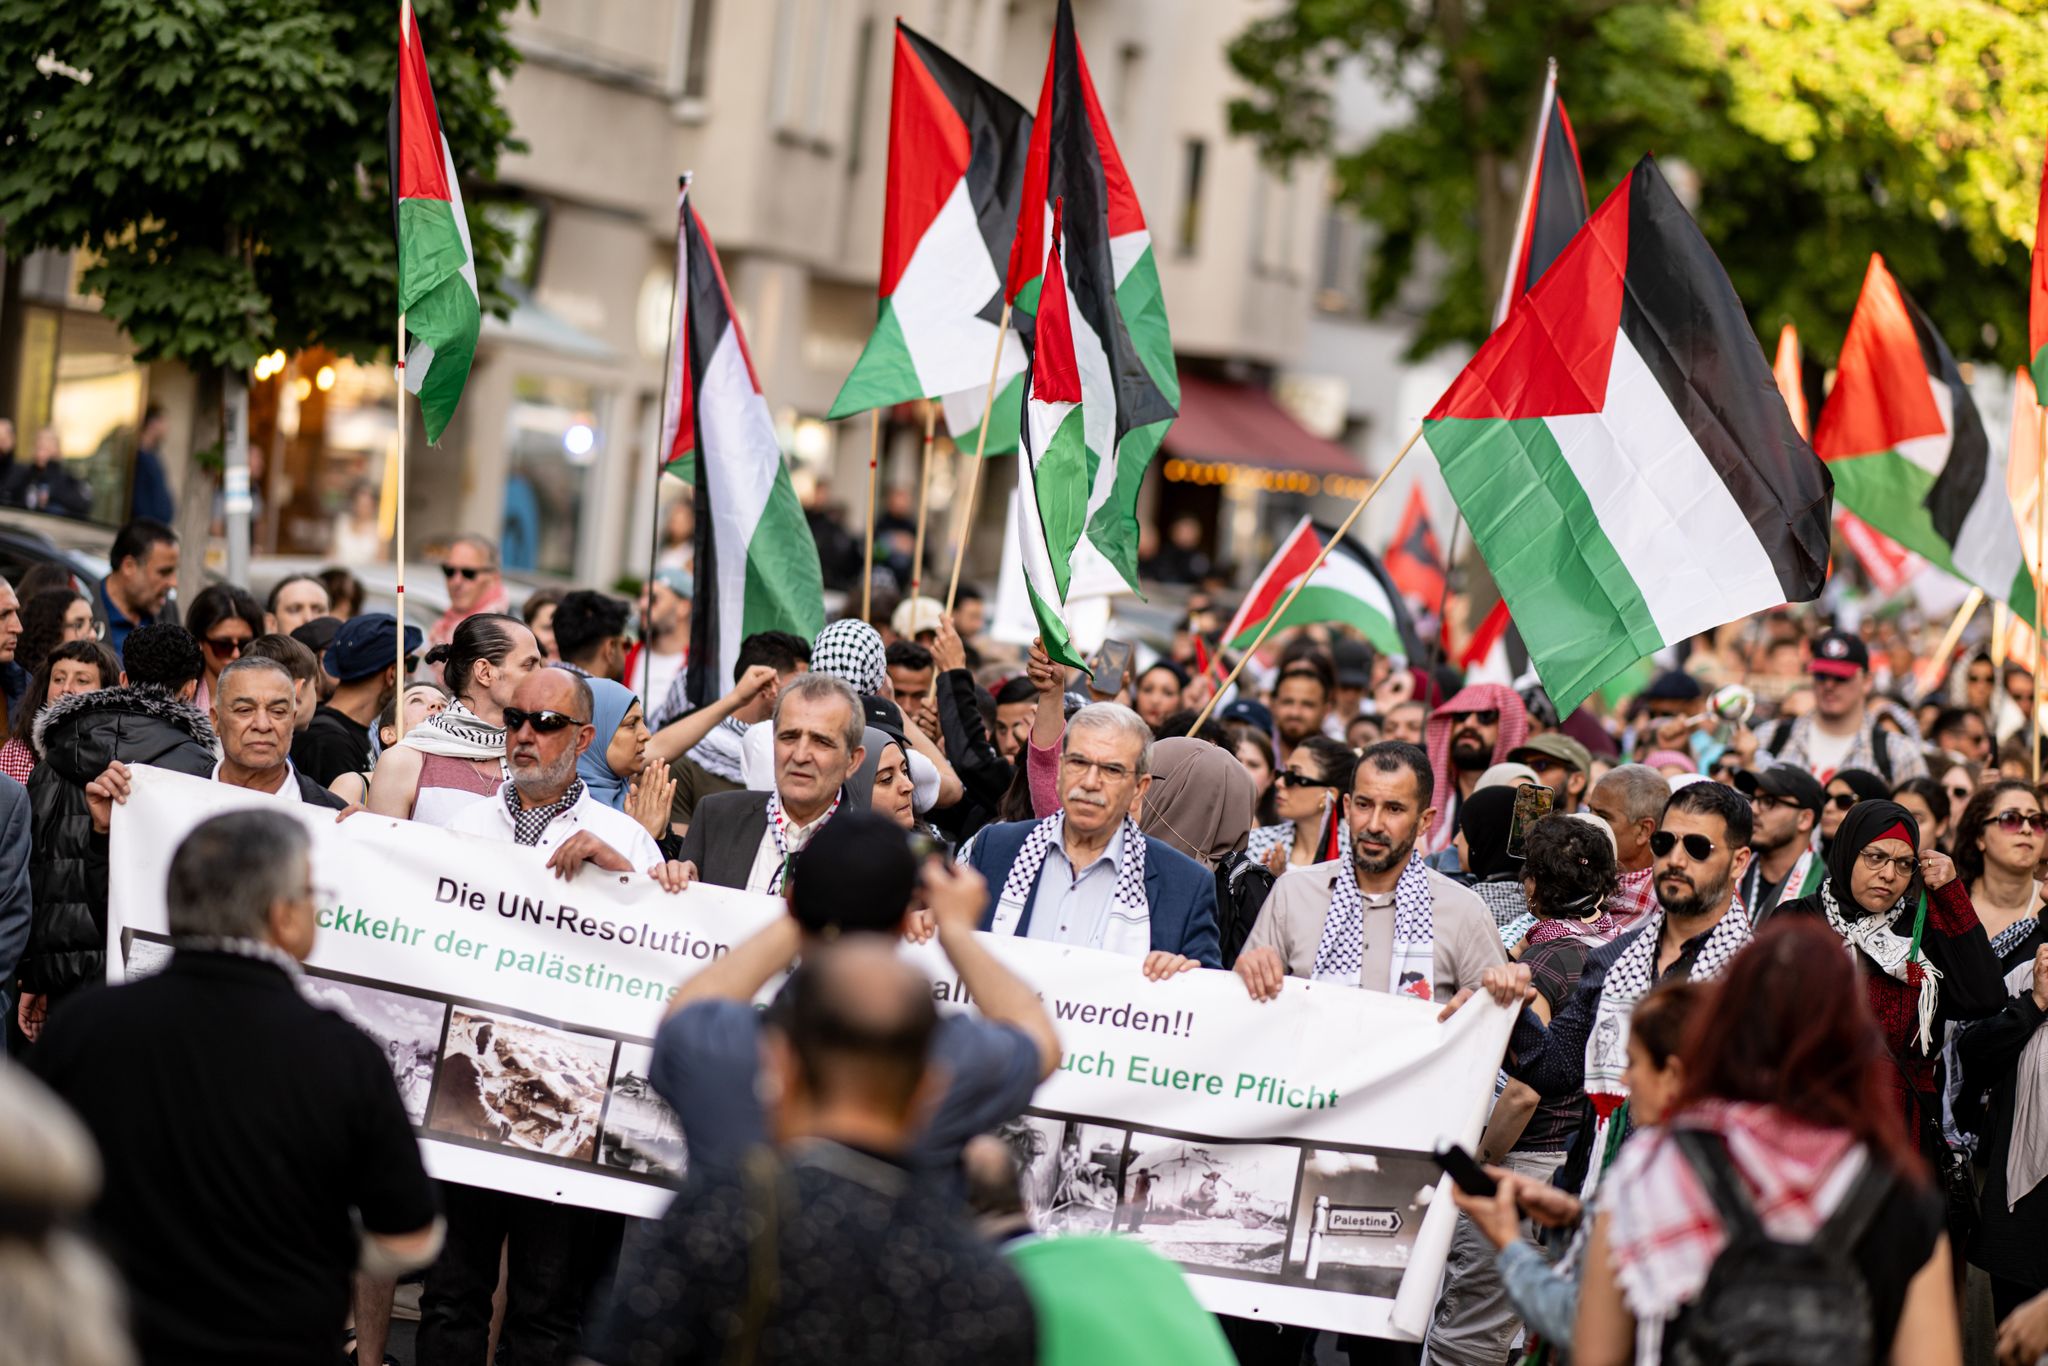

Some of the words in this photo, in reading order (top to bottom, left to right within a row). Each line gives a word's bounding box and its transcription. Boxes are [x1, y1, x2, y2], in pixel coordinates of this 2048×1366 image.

[315, 905, 425, 946] ckkehr
[434, 930, 488, 960] der
[494, 948, 681, 1003] palästinens
[1058, 1051, 1115, 1078] uch
[1127, 1055, 1223, 1094] Euere
[1235, 1073, 1339, 1109] Pflicht
[435, 876, 486, 911] Die
[498, 891, 731, 962] UN-Resolution
[1055, 1000, 1193, 1037] werden!!
[1334, 1215, 1387, 1227] Palestine
